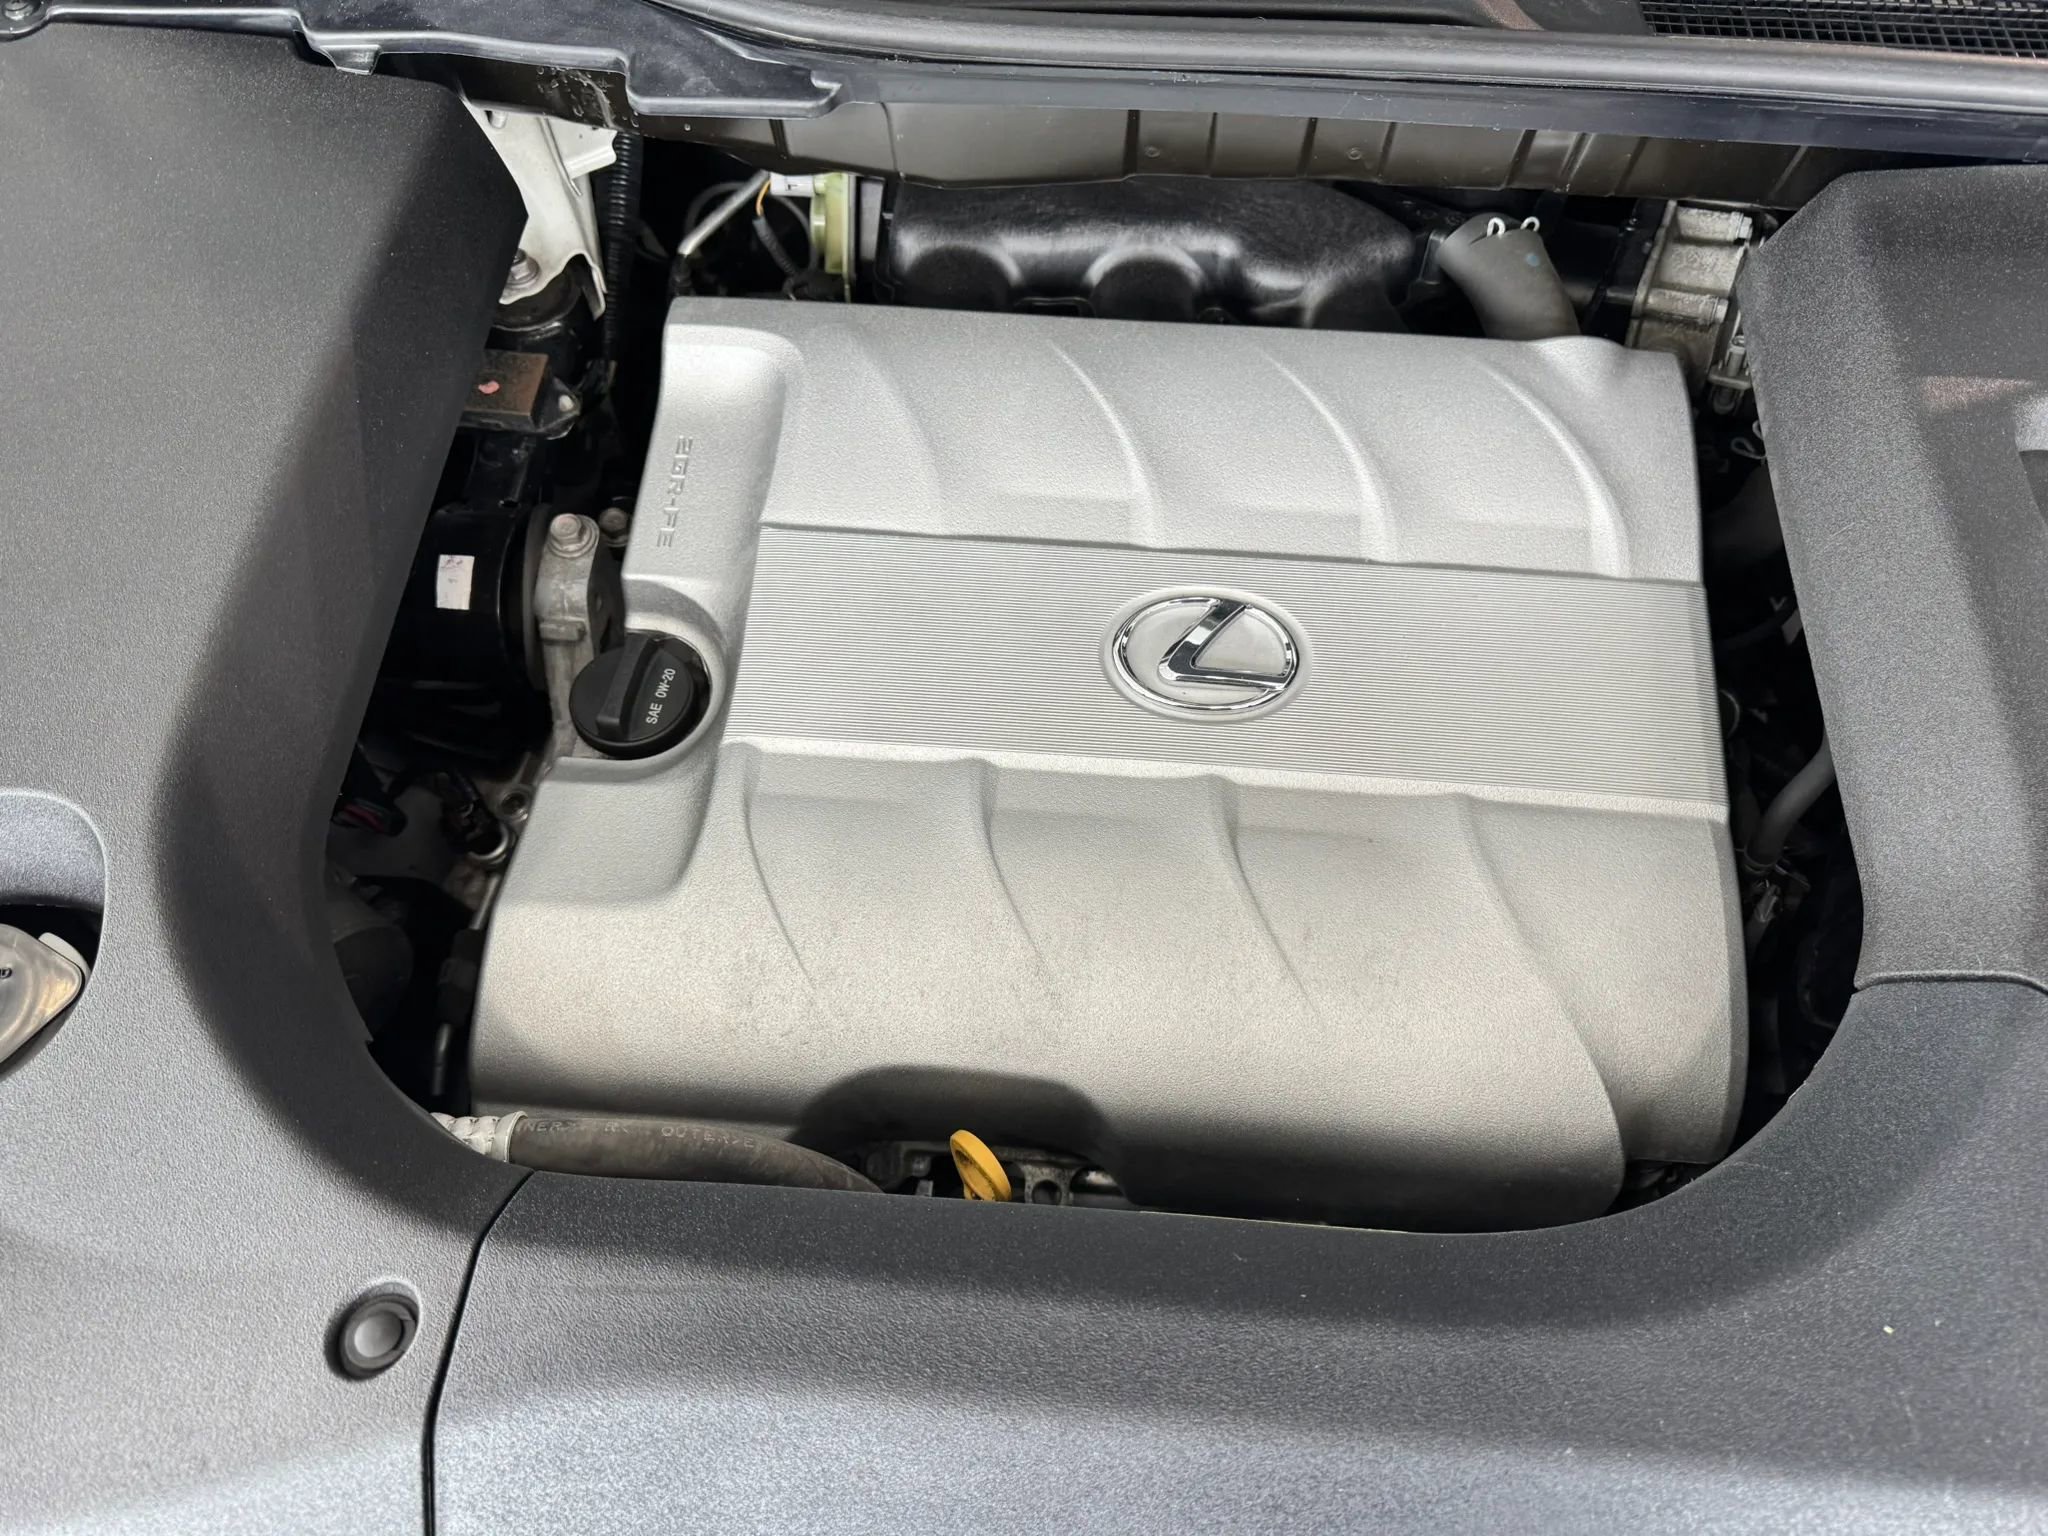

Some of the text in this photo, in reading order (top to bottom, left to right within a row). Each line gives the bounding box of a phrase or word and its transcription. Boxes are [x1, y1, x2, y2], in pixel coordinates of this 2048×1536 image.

[656, 435, 693, 548] 2GR-FE
[645, 668, 677, 725] SAE 0W-20
